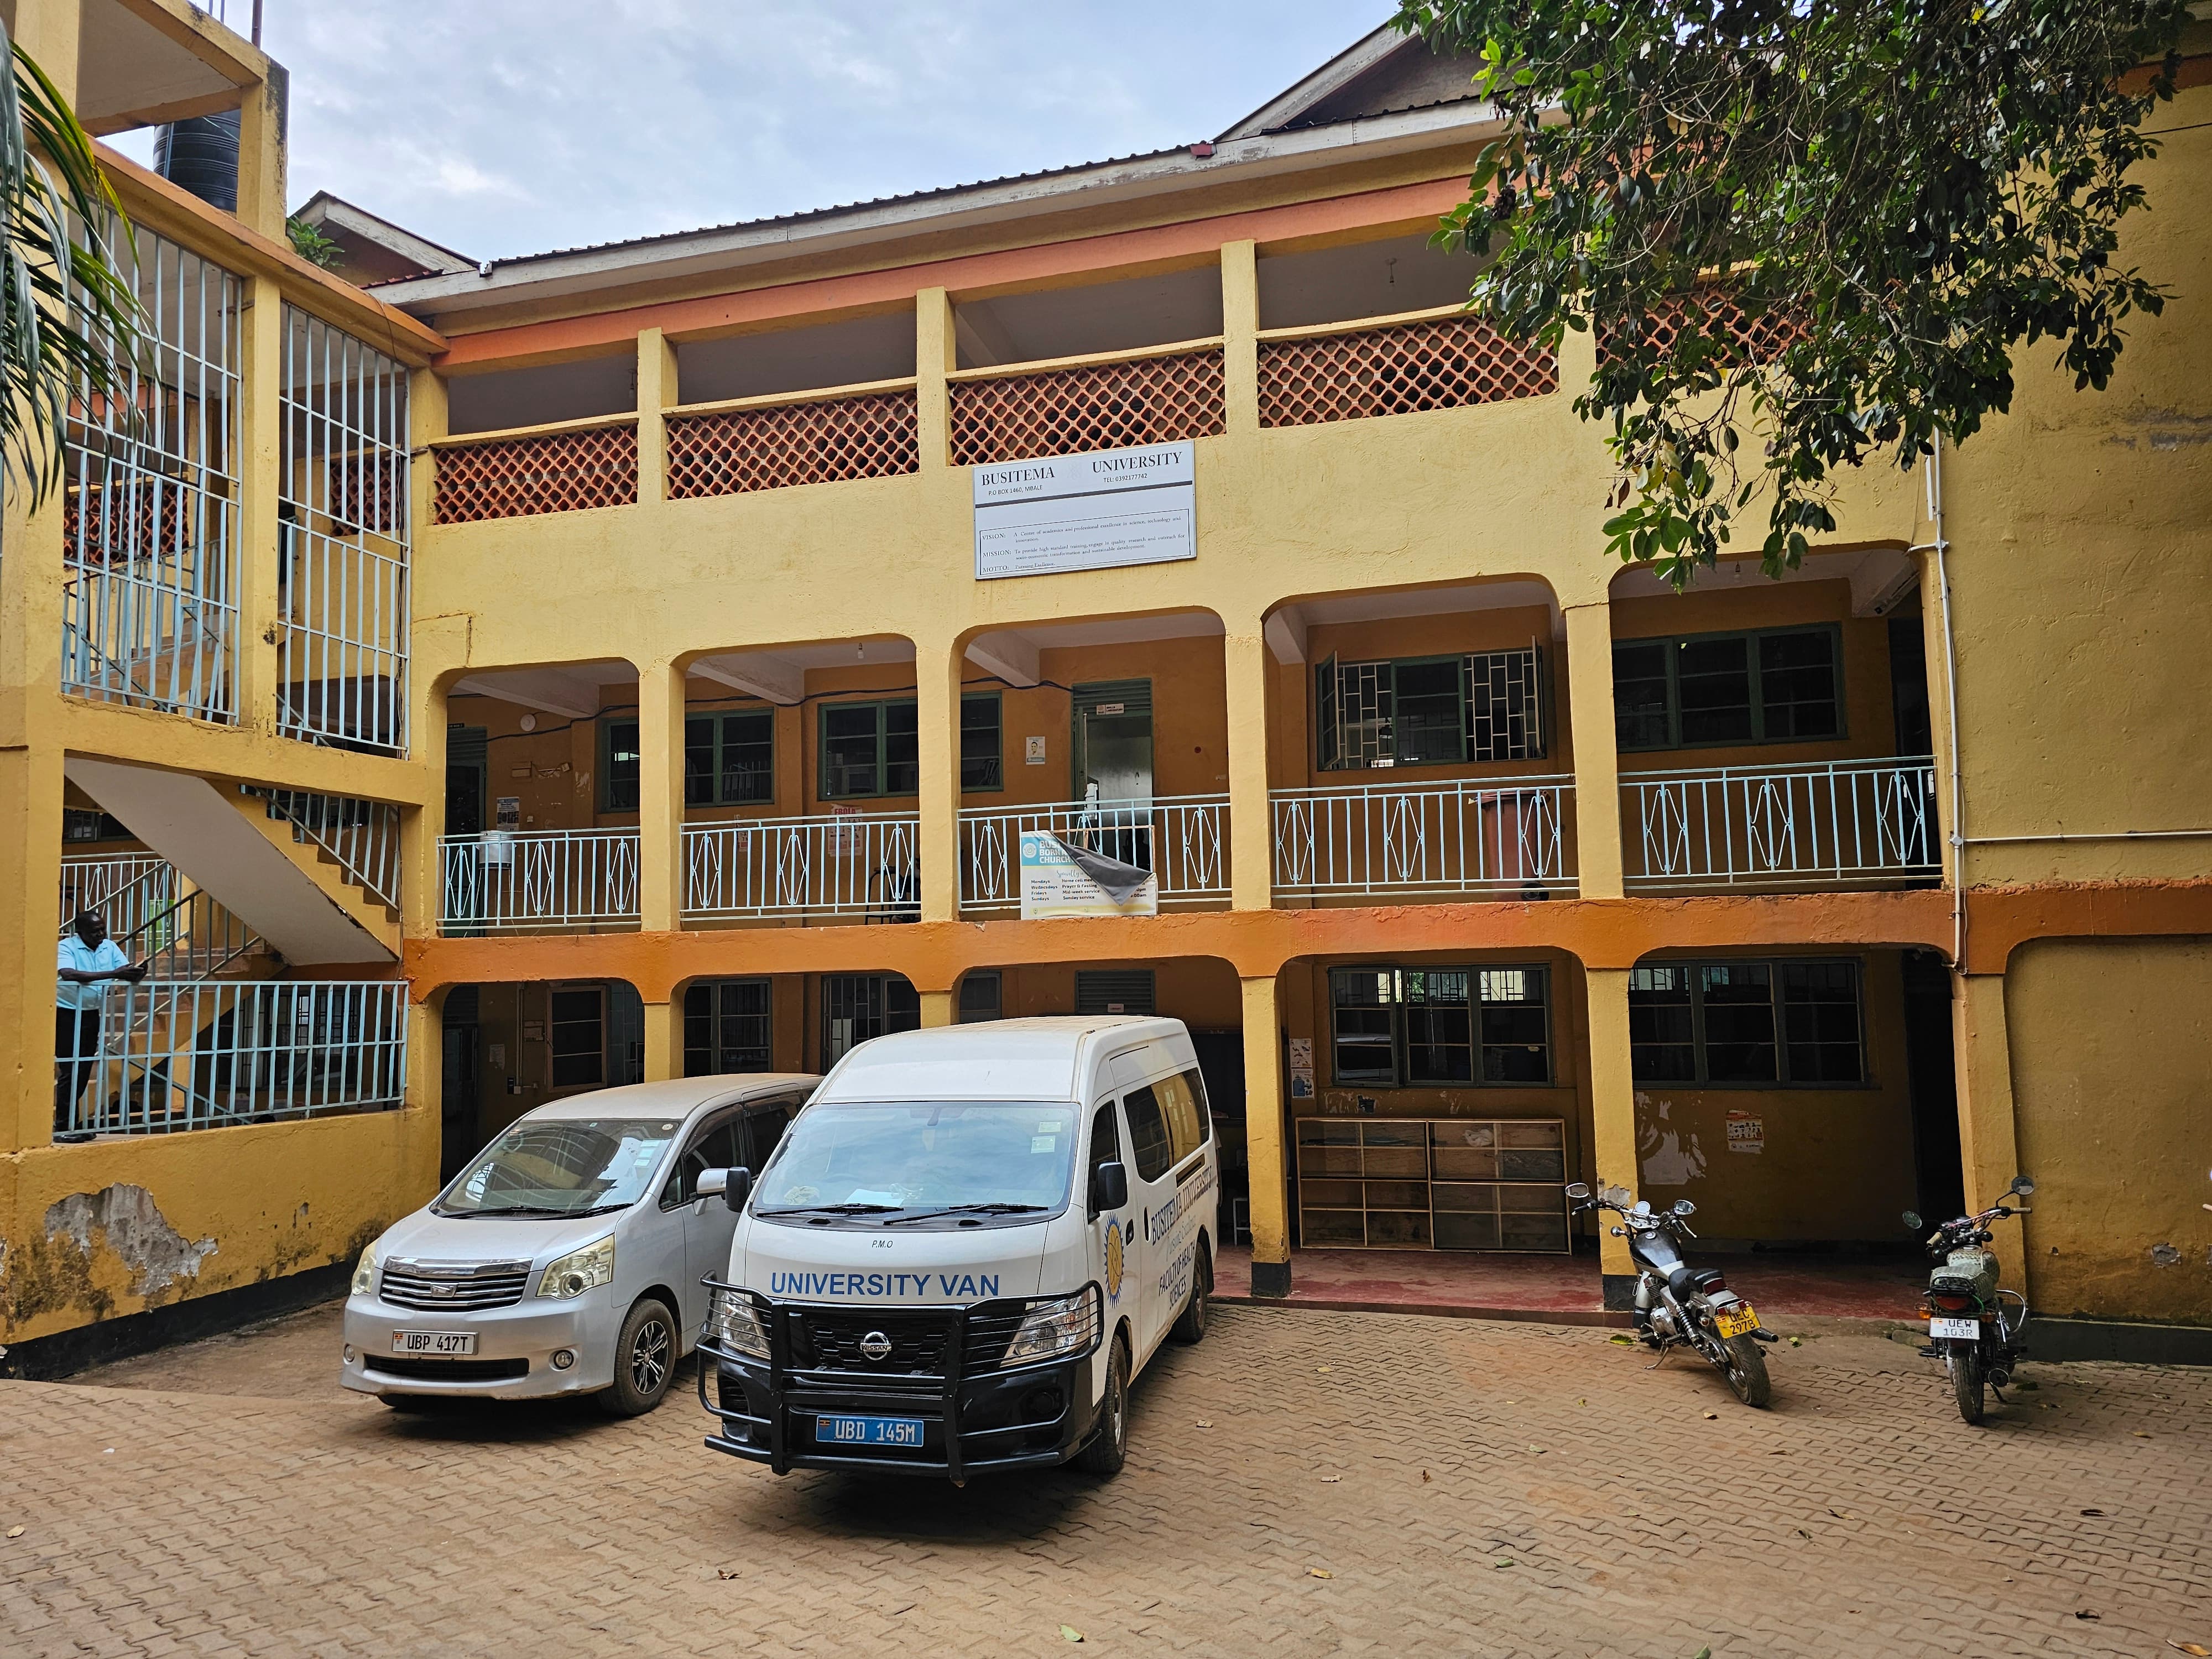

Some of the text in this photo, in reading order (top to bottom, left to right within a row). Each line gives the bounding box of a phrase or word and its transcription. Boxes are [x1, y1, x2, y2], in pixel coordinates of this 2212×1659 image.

[982, 451, 1183, 486] BUSITEMA UNIVERSITY
[1115, 473, 1147, 482] 0392177742
[1073, 524, 1099, 533] professional
[983, 549, 1011, 558] MISSION:
[983, 565, 1010, 573] MOTTO:
[1040, 840, 1061, 849] BUS
[1151, 1165, 1212, 1246] BUSITEMA UNIVERSITY
[872, 1240, 893, 1249] P.M.O
[1159, 1239, 1195, 1297] FACULTY OF HEALTH
[771, 1272, 999, 1296] UNIVERSITY VAN
[1169, 1274, 1186, 1311] SCIENCES
[1729, 1308, 1750, 1323] UEC
[1729, 1319, 1756, 1335] 297B
[1948, 1319, 1971, 1328] UEW
[407, 1334, 468, 1352] UBP 417T
[835, 1420, 916, 1443] UBD 145M
